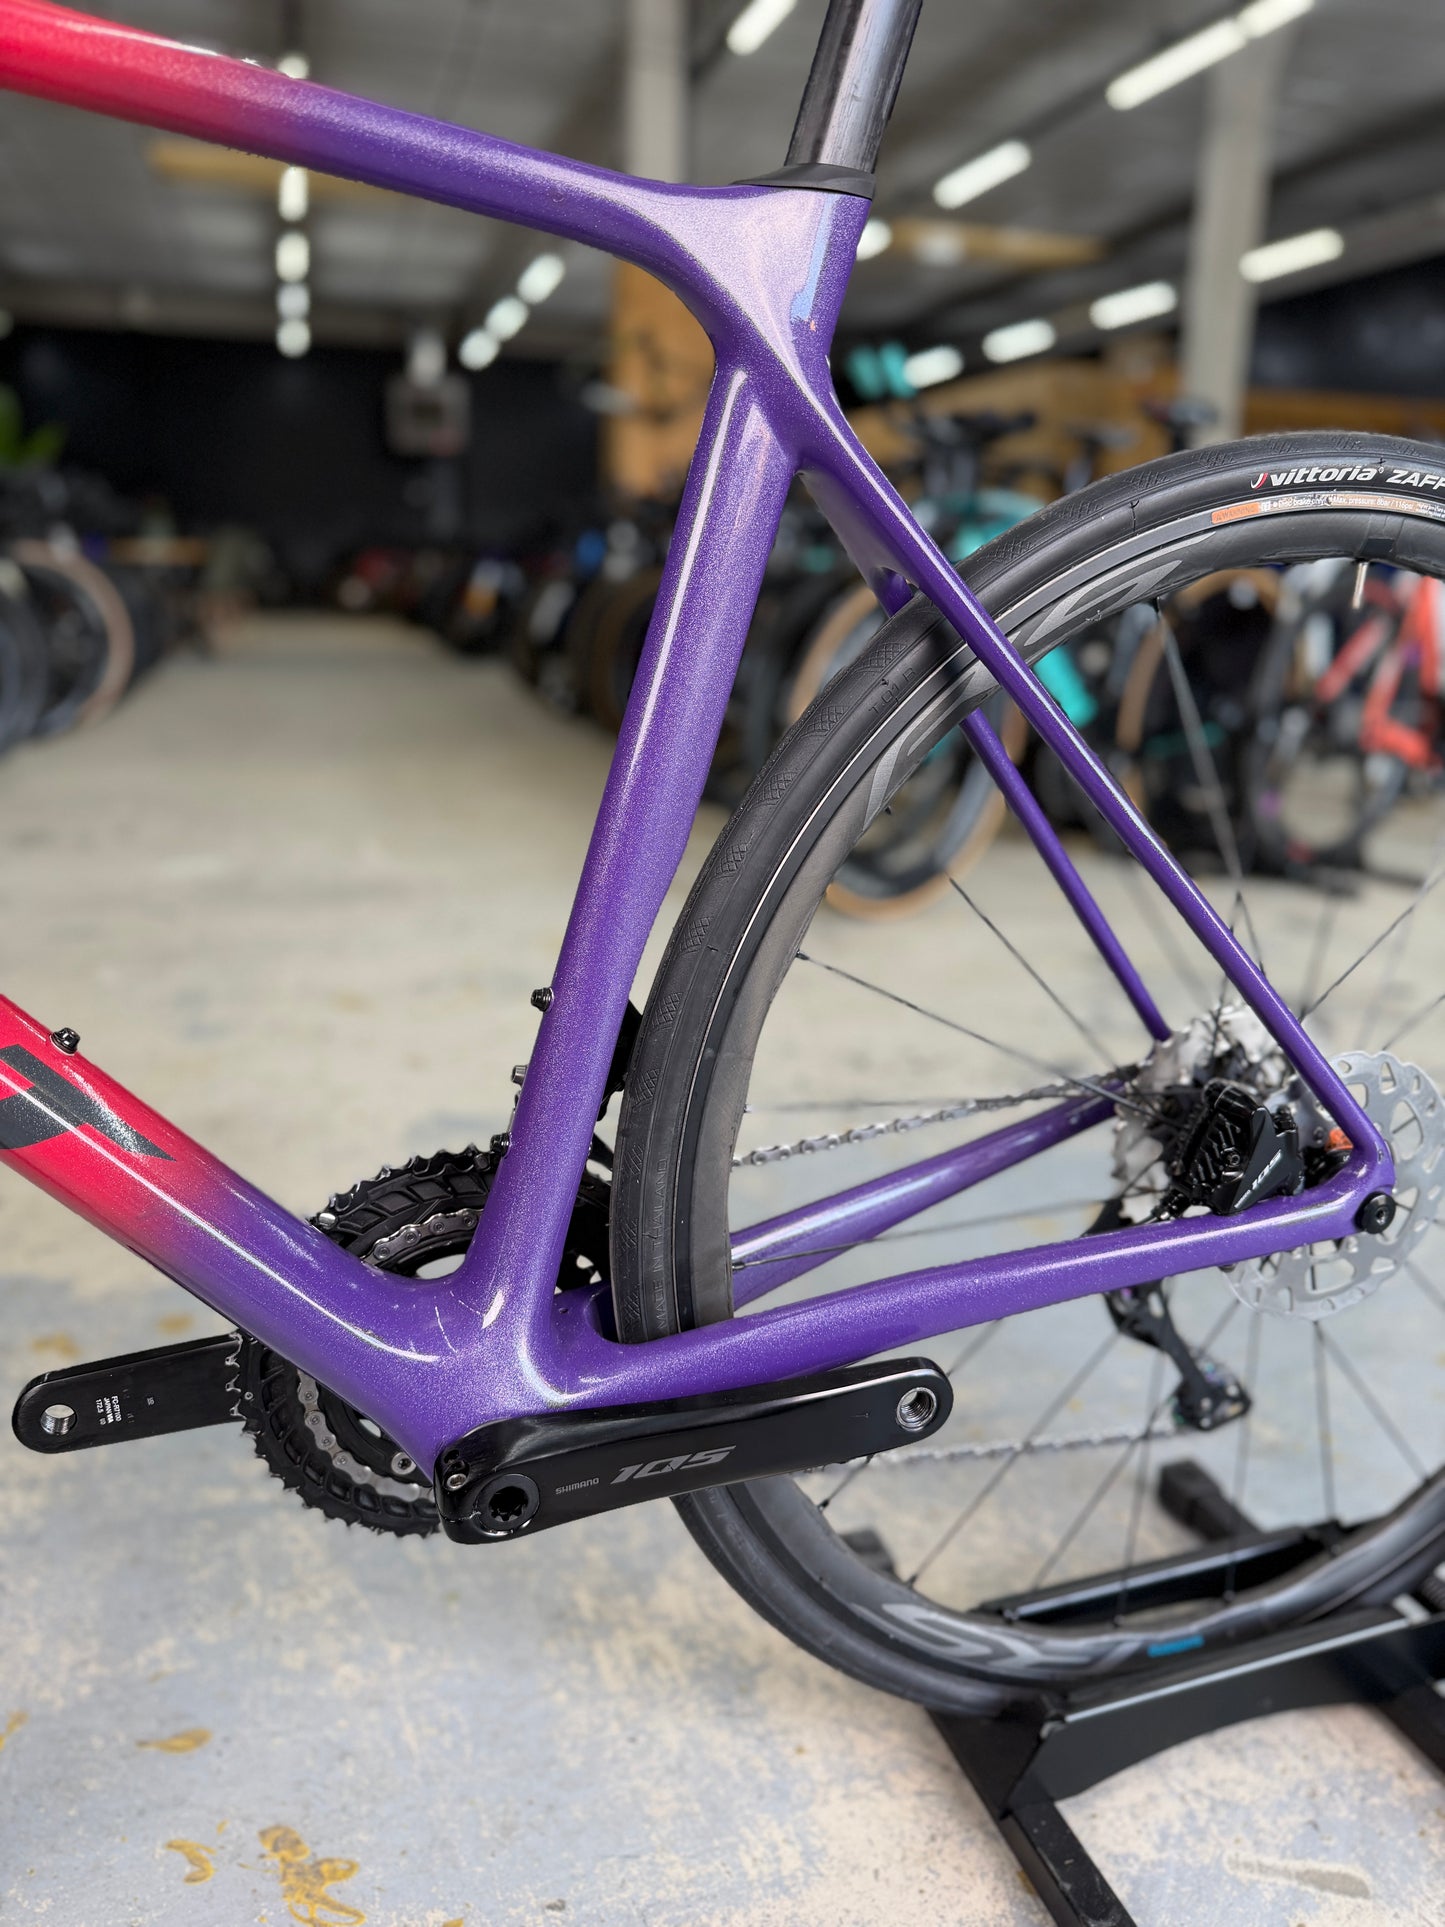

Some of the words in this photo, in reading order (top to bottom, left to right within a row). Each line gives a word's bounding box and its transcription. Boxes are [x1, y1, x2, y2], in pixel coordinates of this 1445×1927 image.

[1270, 465, 1376, 487] vittoria
[653, 1158, 668, 1250] THAILAND
[652, 1256, 665, 1273] IN
[655, 1279, 668, 1329] MADE
[555, 1477, 600, 1495] SHIMANO
[610, 1445, 737, 1484] 105
